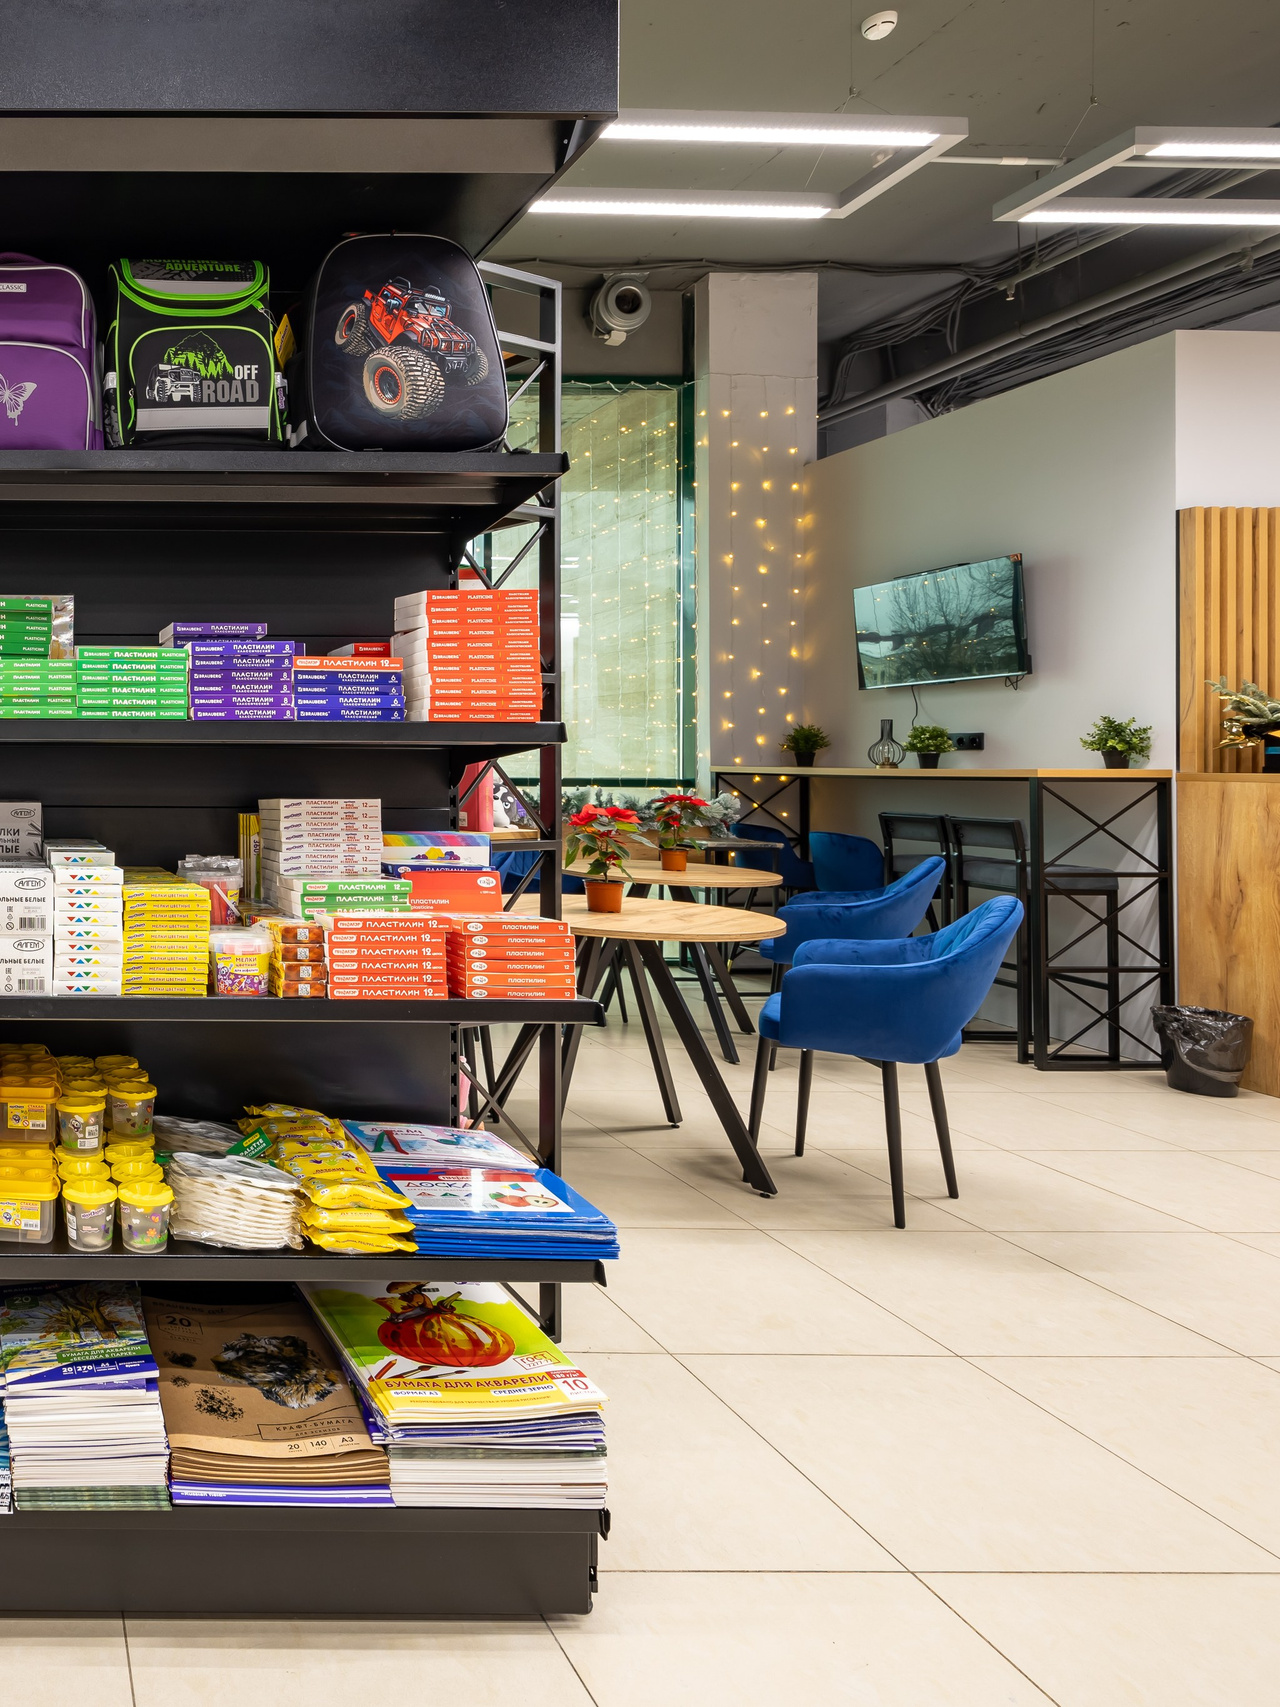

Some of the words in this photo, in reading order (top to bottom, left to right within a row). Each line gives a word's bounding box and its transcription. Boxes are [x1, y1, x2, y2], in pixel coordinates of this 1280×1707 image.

[166, 262, 242, 272] ADVENTURE
[234, 364, 260, 380] OFF
[202, 380, 260, 404] ROAD
[428, 920, 438, 928] 12
[423, 988, 433, 996] 12
[165, 1316, 192, 1328] 20
[62, 1350, 89, 1358] БУМАГА
[520, 1353, 548, 1364] ГОСТ
[384, 1380, 442, 1389] БУМАГА
[444, 1381, 473, 1389] ДЛЯ
[476, 1374, 549, 1388] АКВАРЕЛИ
[562, 1378, 589, 1390] 10
[493, 1387, 527, 1395] СРЕДНЕЕ
[528, 1384, 554, 1392] ЗЕРНО
[275, 1419, 354, 1432] КРАФТ-БУМАГА
[309, 1440, 327, 1448] 140
